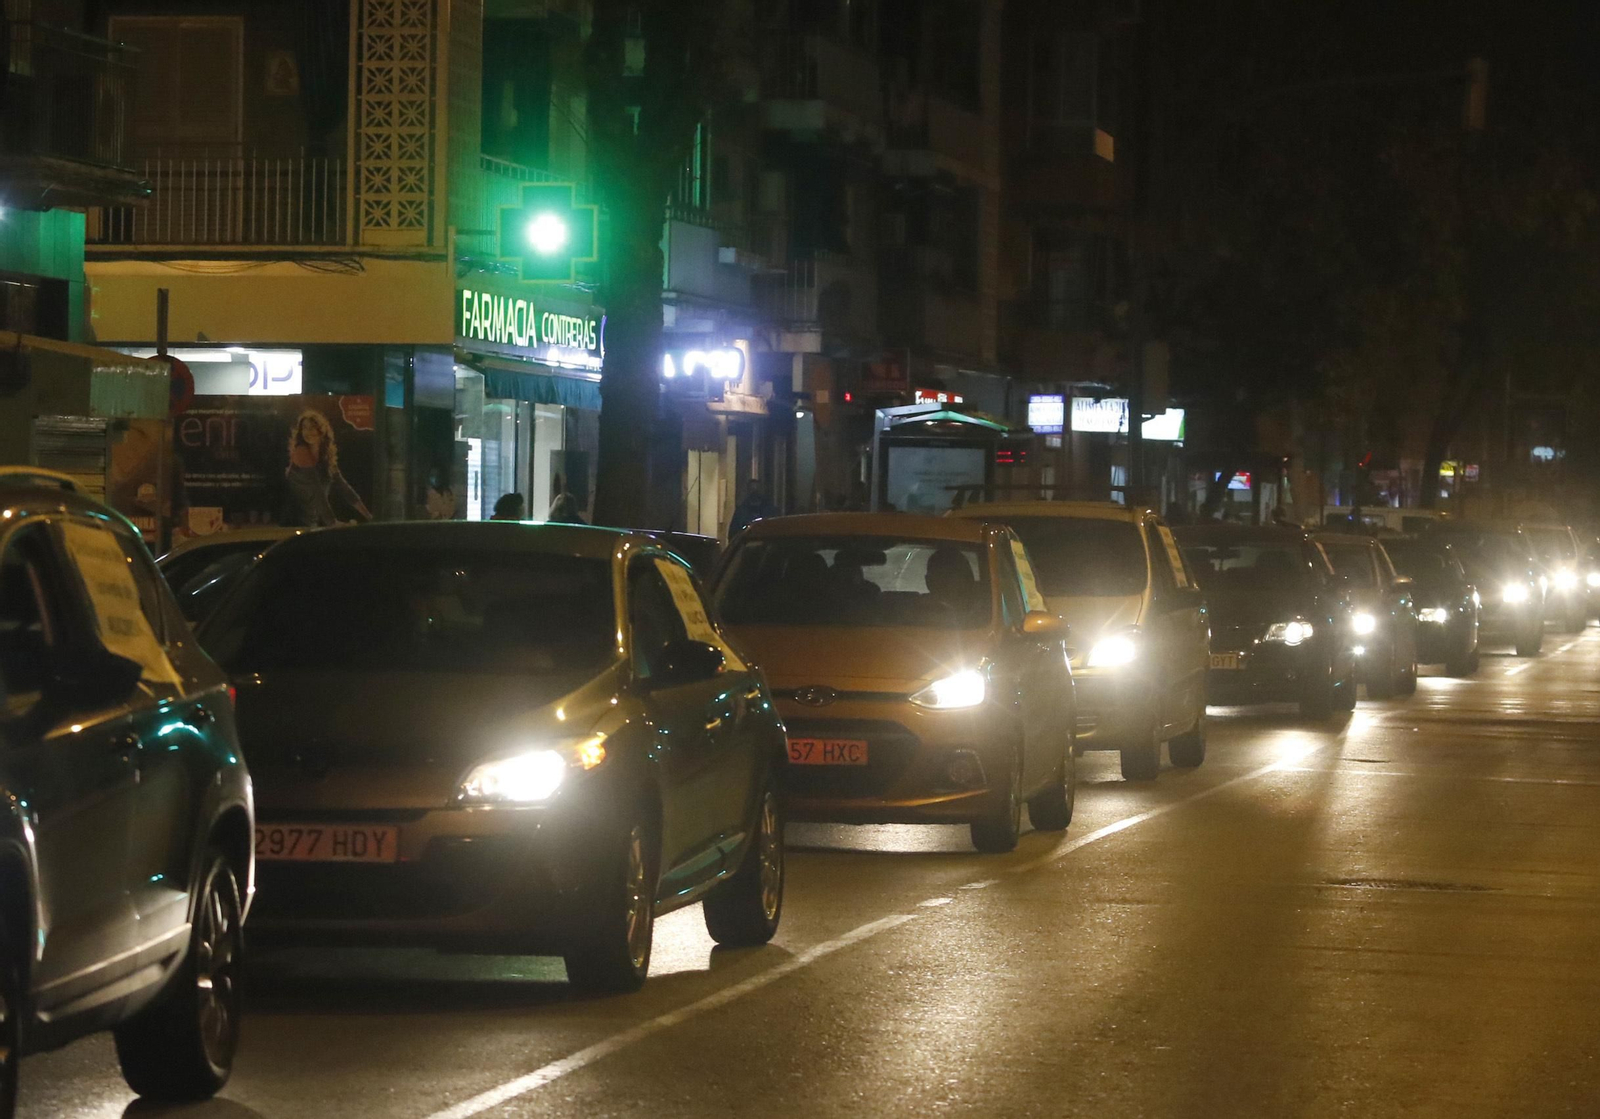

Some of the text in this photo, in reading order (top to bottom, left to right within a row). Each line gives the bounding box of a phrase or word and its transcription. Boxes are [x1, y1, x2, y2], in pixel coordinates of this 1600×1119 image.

[462, 289, 537, 348] FARMACIA
[823, 743, 860, 762] HXC
[255, 829, 388, 857] 2977 HDY
